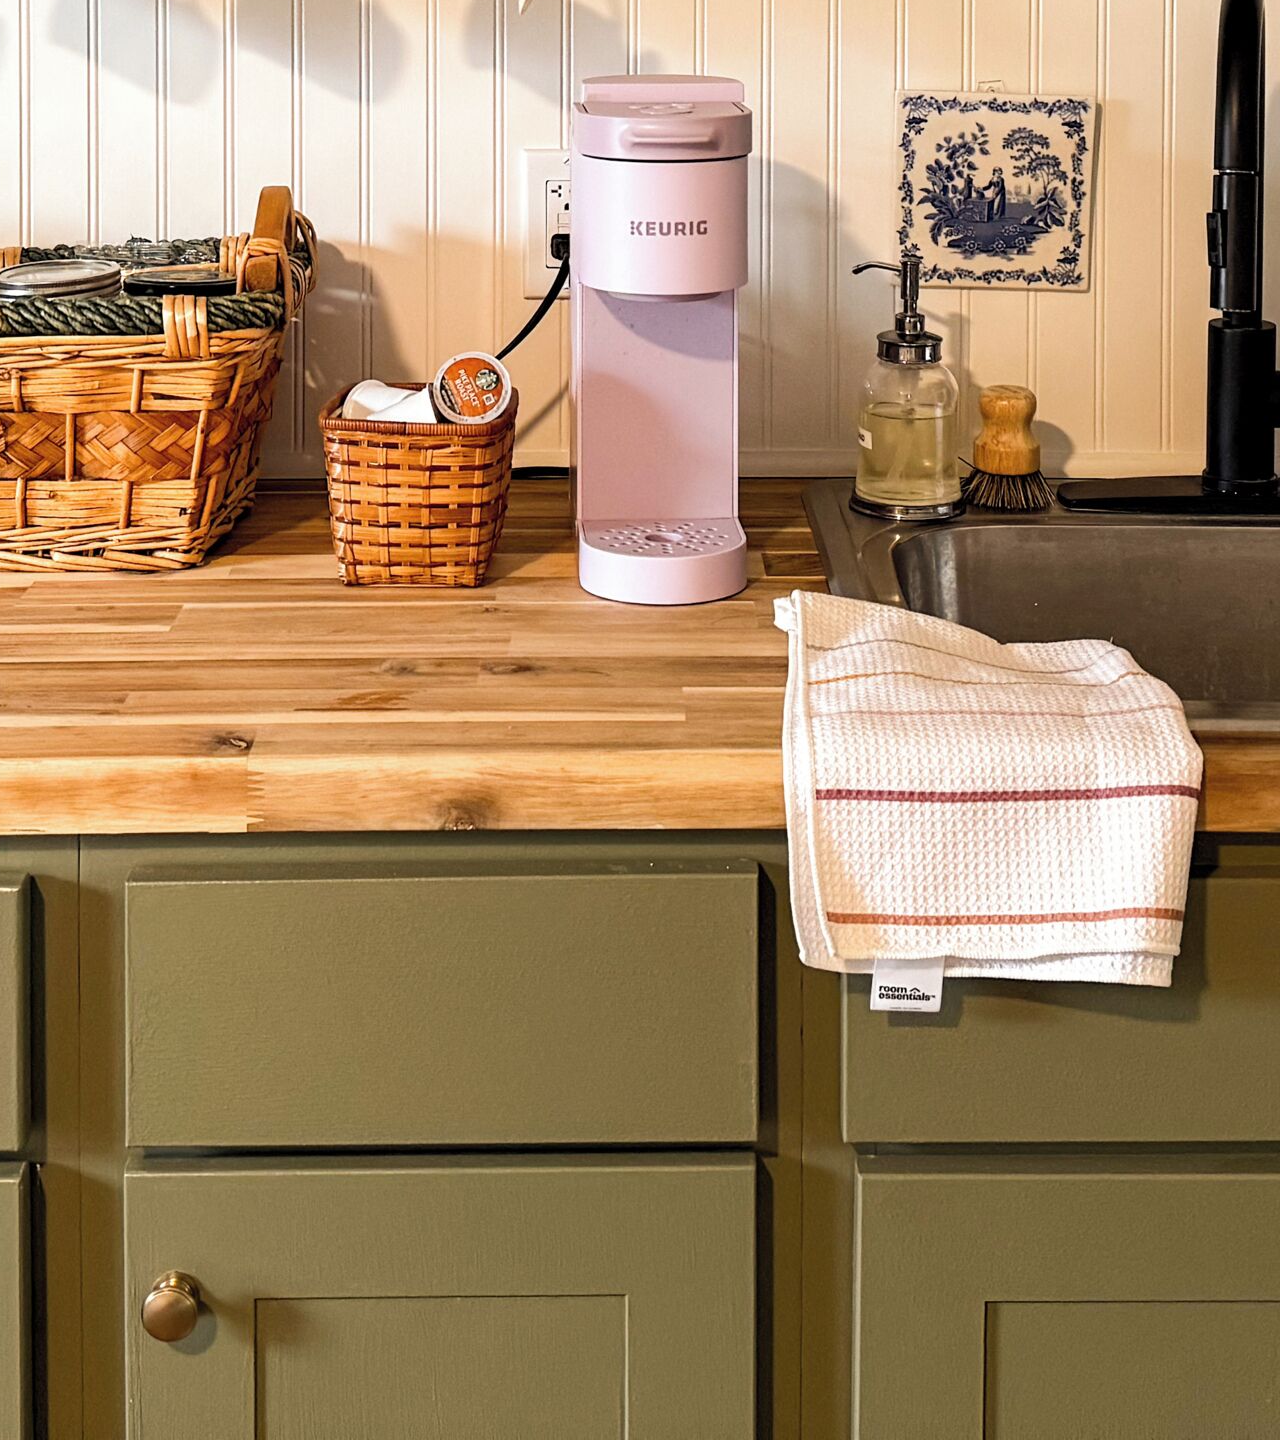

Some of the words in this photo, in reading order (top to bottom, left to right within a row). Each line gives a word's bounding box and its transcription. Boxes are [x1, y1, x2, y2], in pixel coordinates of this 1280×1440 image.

[630, 220, 708, 236] KEURIG
[454, 378, 470, 401] ROAST
[458, 369, 470, 385] PIKE
[464, 383, 480, 407] PLACE
[878, 985, 908, 994] room
